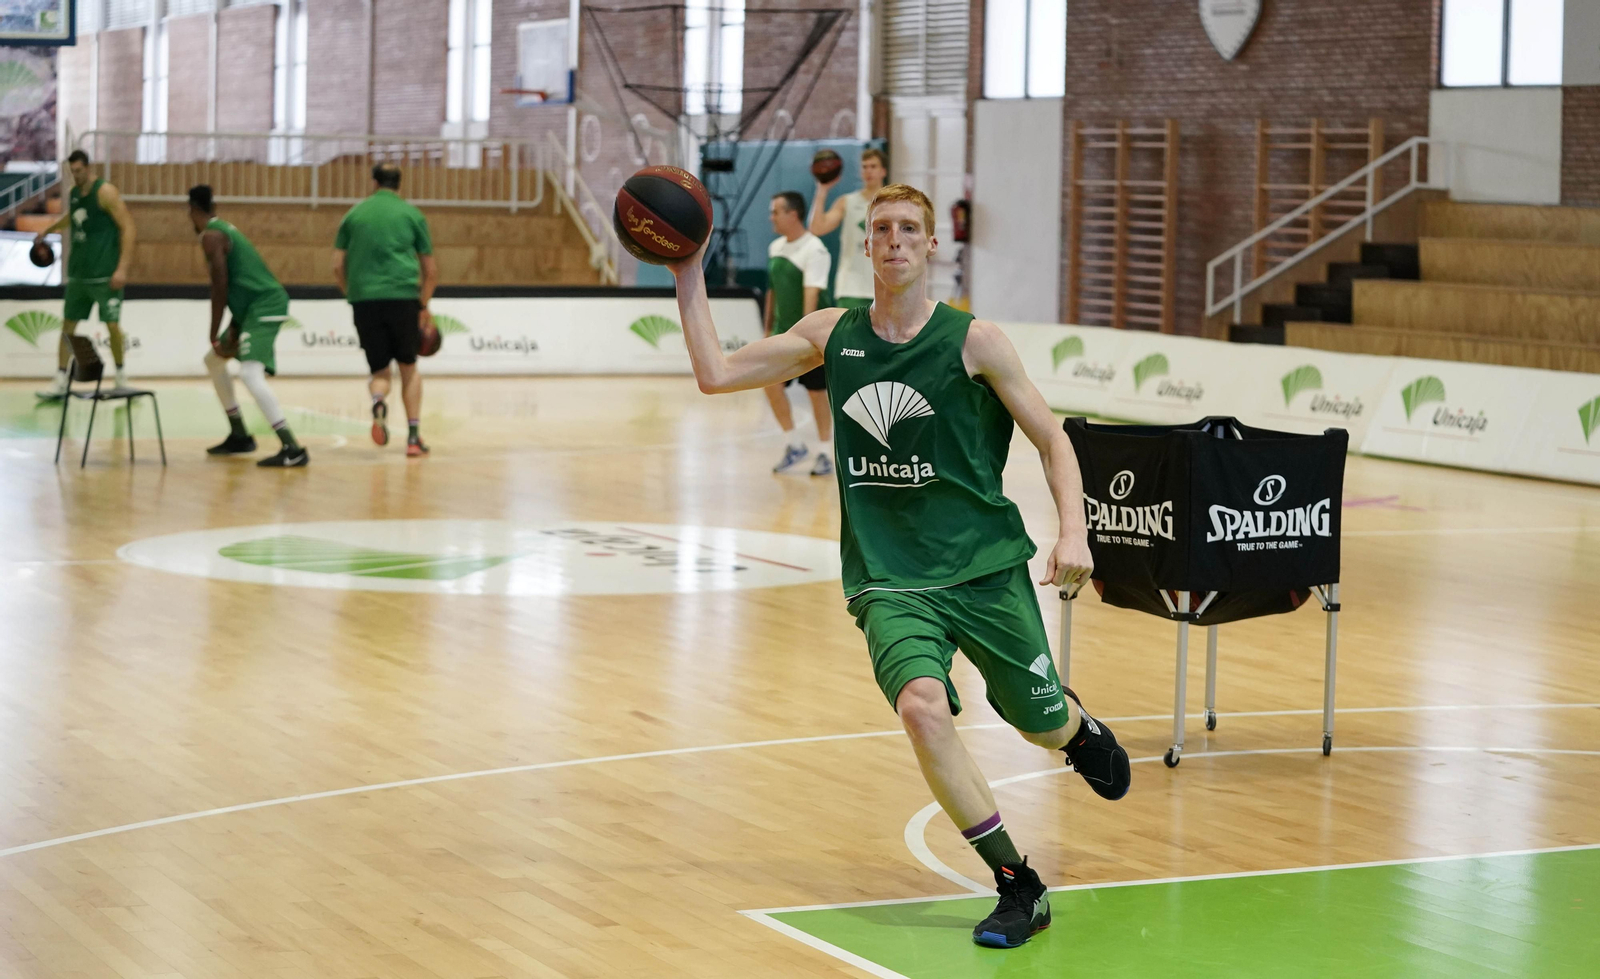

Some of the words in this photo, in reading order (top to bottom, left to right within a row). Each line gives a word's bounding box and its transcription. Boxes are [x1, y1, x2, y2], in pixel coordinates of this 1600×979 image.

[301, 331, 360, 347] Unica
[469, 335, 539, 355] Unicaja
[1310, 394, 1364, 419] Unicaja
[1433, 407, 1488, 435] Unicaja
[848, 454, 935, 484] Unicaja
[1083, 492, 1173, 540] PALDING
[1206, 498, 1331, 543] SPALDING
[1096, 534, 1111, 544] TRUE
[1112, 536, 1121, 544] TO
[1121, 536, 1133, 546] THE
[1133, 538, 1150, 548] GAME
[1237, 543, 1255, 551] TRUE
[1256, 542, 1265, 550] TO
[1265, 541, 1278, 550] THE
[1279, 540, 1299, 550] GAME
